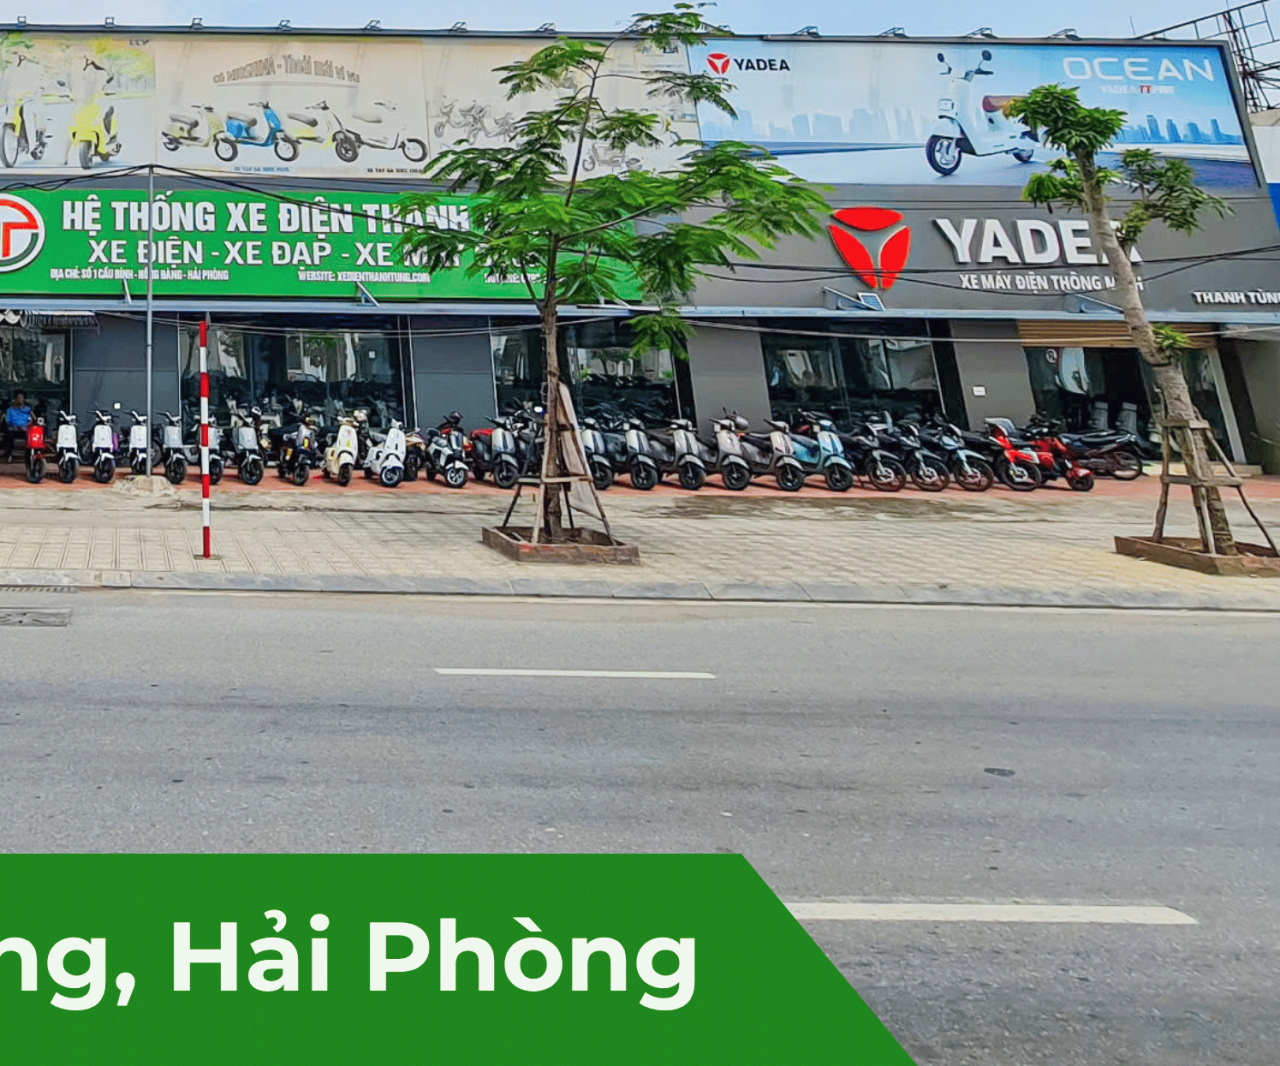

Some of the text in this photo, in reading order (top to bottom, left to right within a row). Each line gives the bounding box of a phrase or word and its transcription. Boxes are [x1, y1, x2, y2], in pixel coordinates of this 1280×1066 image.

[733, 58, 791, 71] YADEA
[1063, 57, 1215, 82] OCEAN
[62, 194, 102, 237] HỆ
[111, 190, 216, 232] THỐNG
[226, 202, 268, 233] XE
[278, 196, 354, 240] ĐIỆN
[88, 240, 128, 264] XE
[137, 236, 204, 269] ĐIỆN
[224, 241, 263, 265] XE
[271, 241, 332, 271] ĐẠP
[355, 242, 394, 267] XE
[960, 274, 979, 289] XE
[980, 271, 1013, 289] MÁY
[1015, 271, 1048, 294] ĐIỆN
[1050, 271, 1102, 291] THÔNG
[1192, 288, 1280, 304] THANH TÙN
